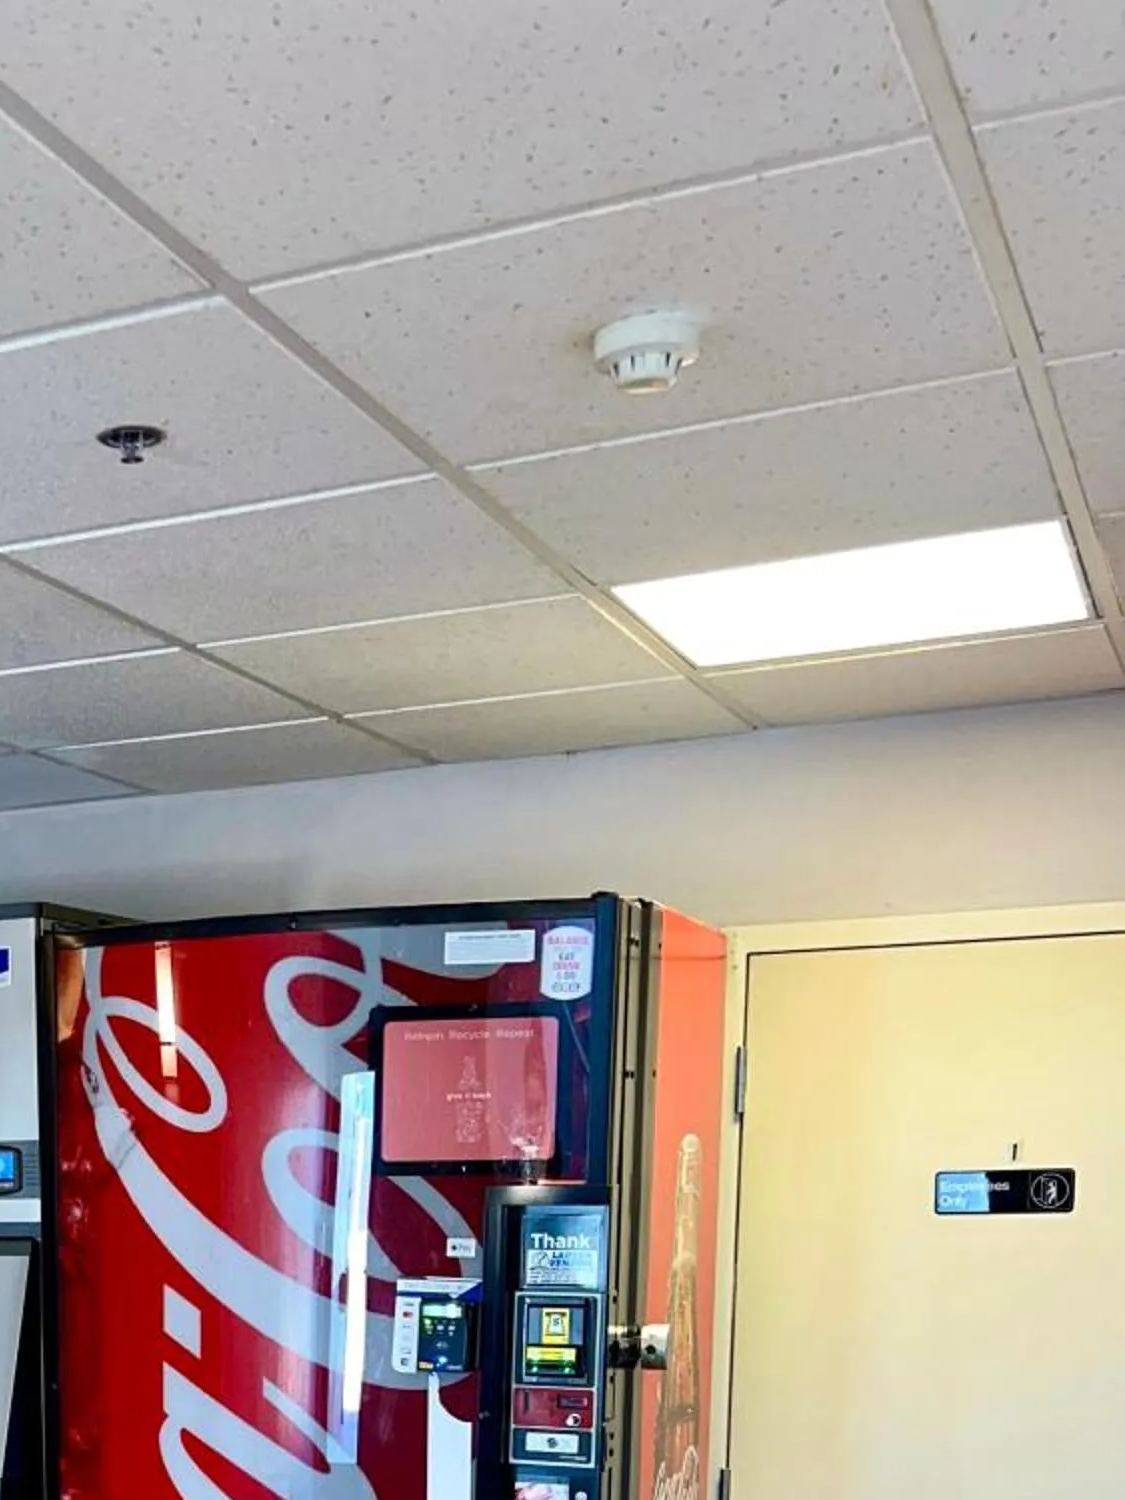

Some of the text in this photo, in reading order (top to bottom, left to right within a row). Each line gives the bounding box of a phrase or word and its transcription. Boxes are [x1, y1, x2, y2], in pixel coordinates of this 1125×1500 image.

[448, 1029, 491, 1041] Recycle
[496, 1028, 535, 1040] Repeat
[530, 1232, 591, 1249] Thank
